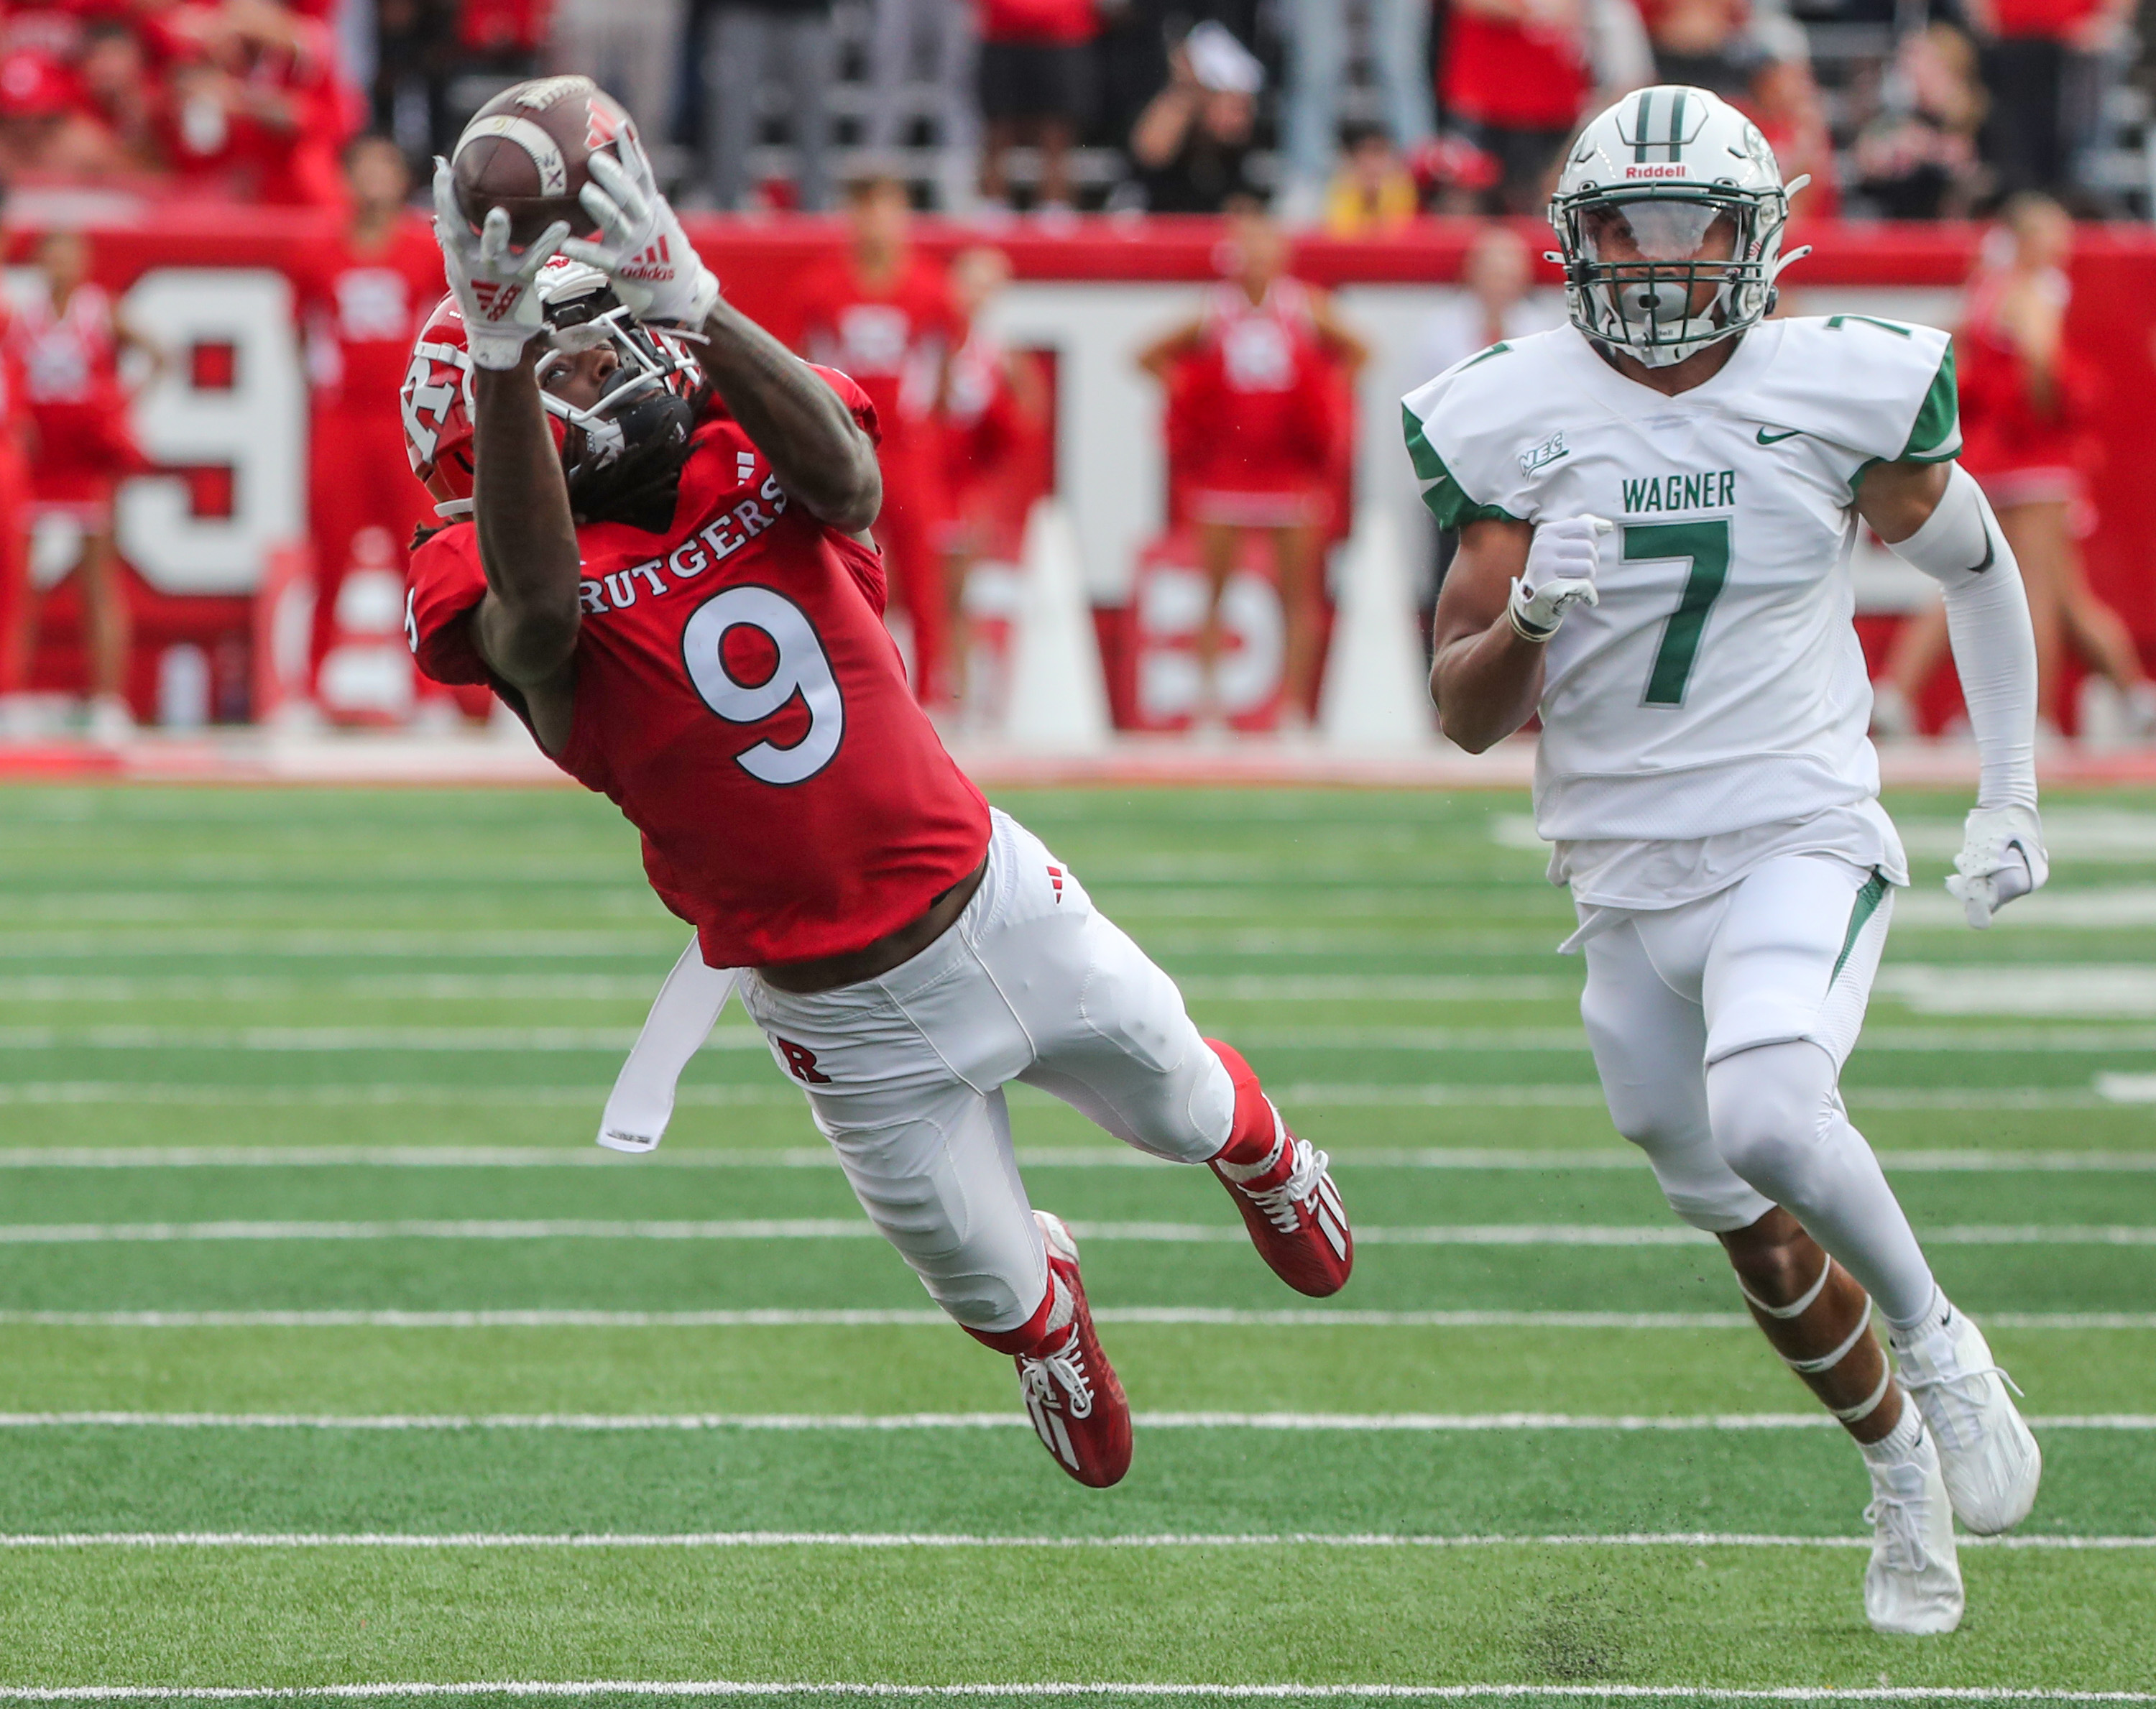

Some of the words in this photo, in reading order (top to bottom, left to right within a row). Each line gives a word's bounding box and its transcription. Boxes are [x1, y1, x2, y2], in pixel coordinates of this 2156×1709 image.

[1626, 166, 1686, 179] Riddell
[620, 265, 675, 282] adidas
[1519, 431, 1564, 477] NEC
[1622, 470, 1736, 513] WAGNER
[578, 472, 788, 616] RUTGERS
[1618, 514, 1734, 710] 7
[681, 583, 846, 788] 9
[776, 1036, 833, 1085] R
